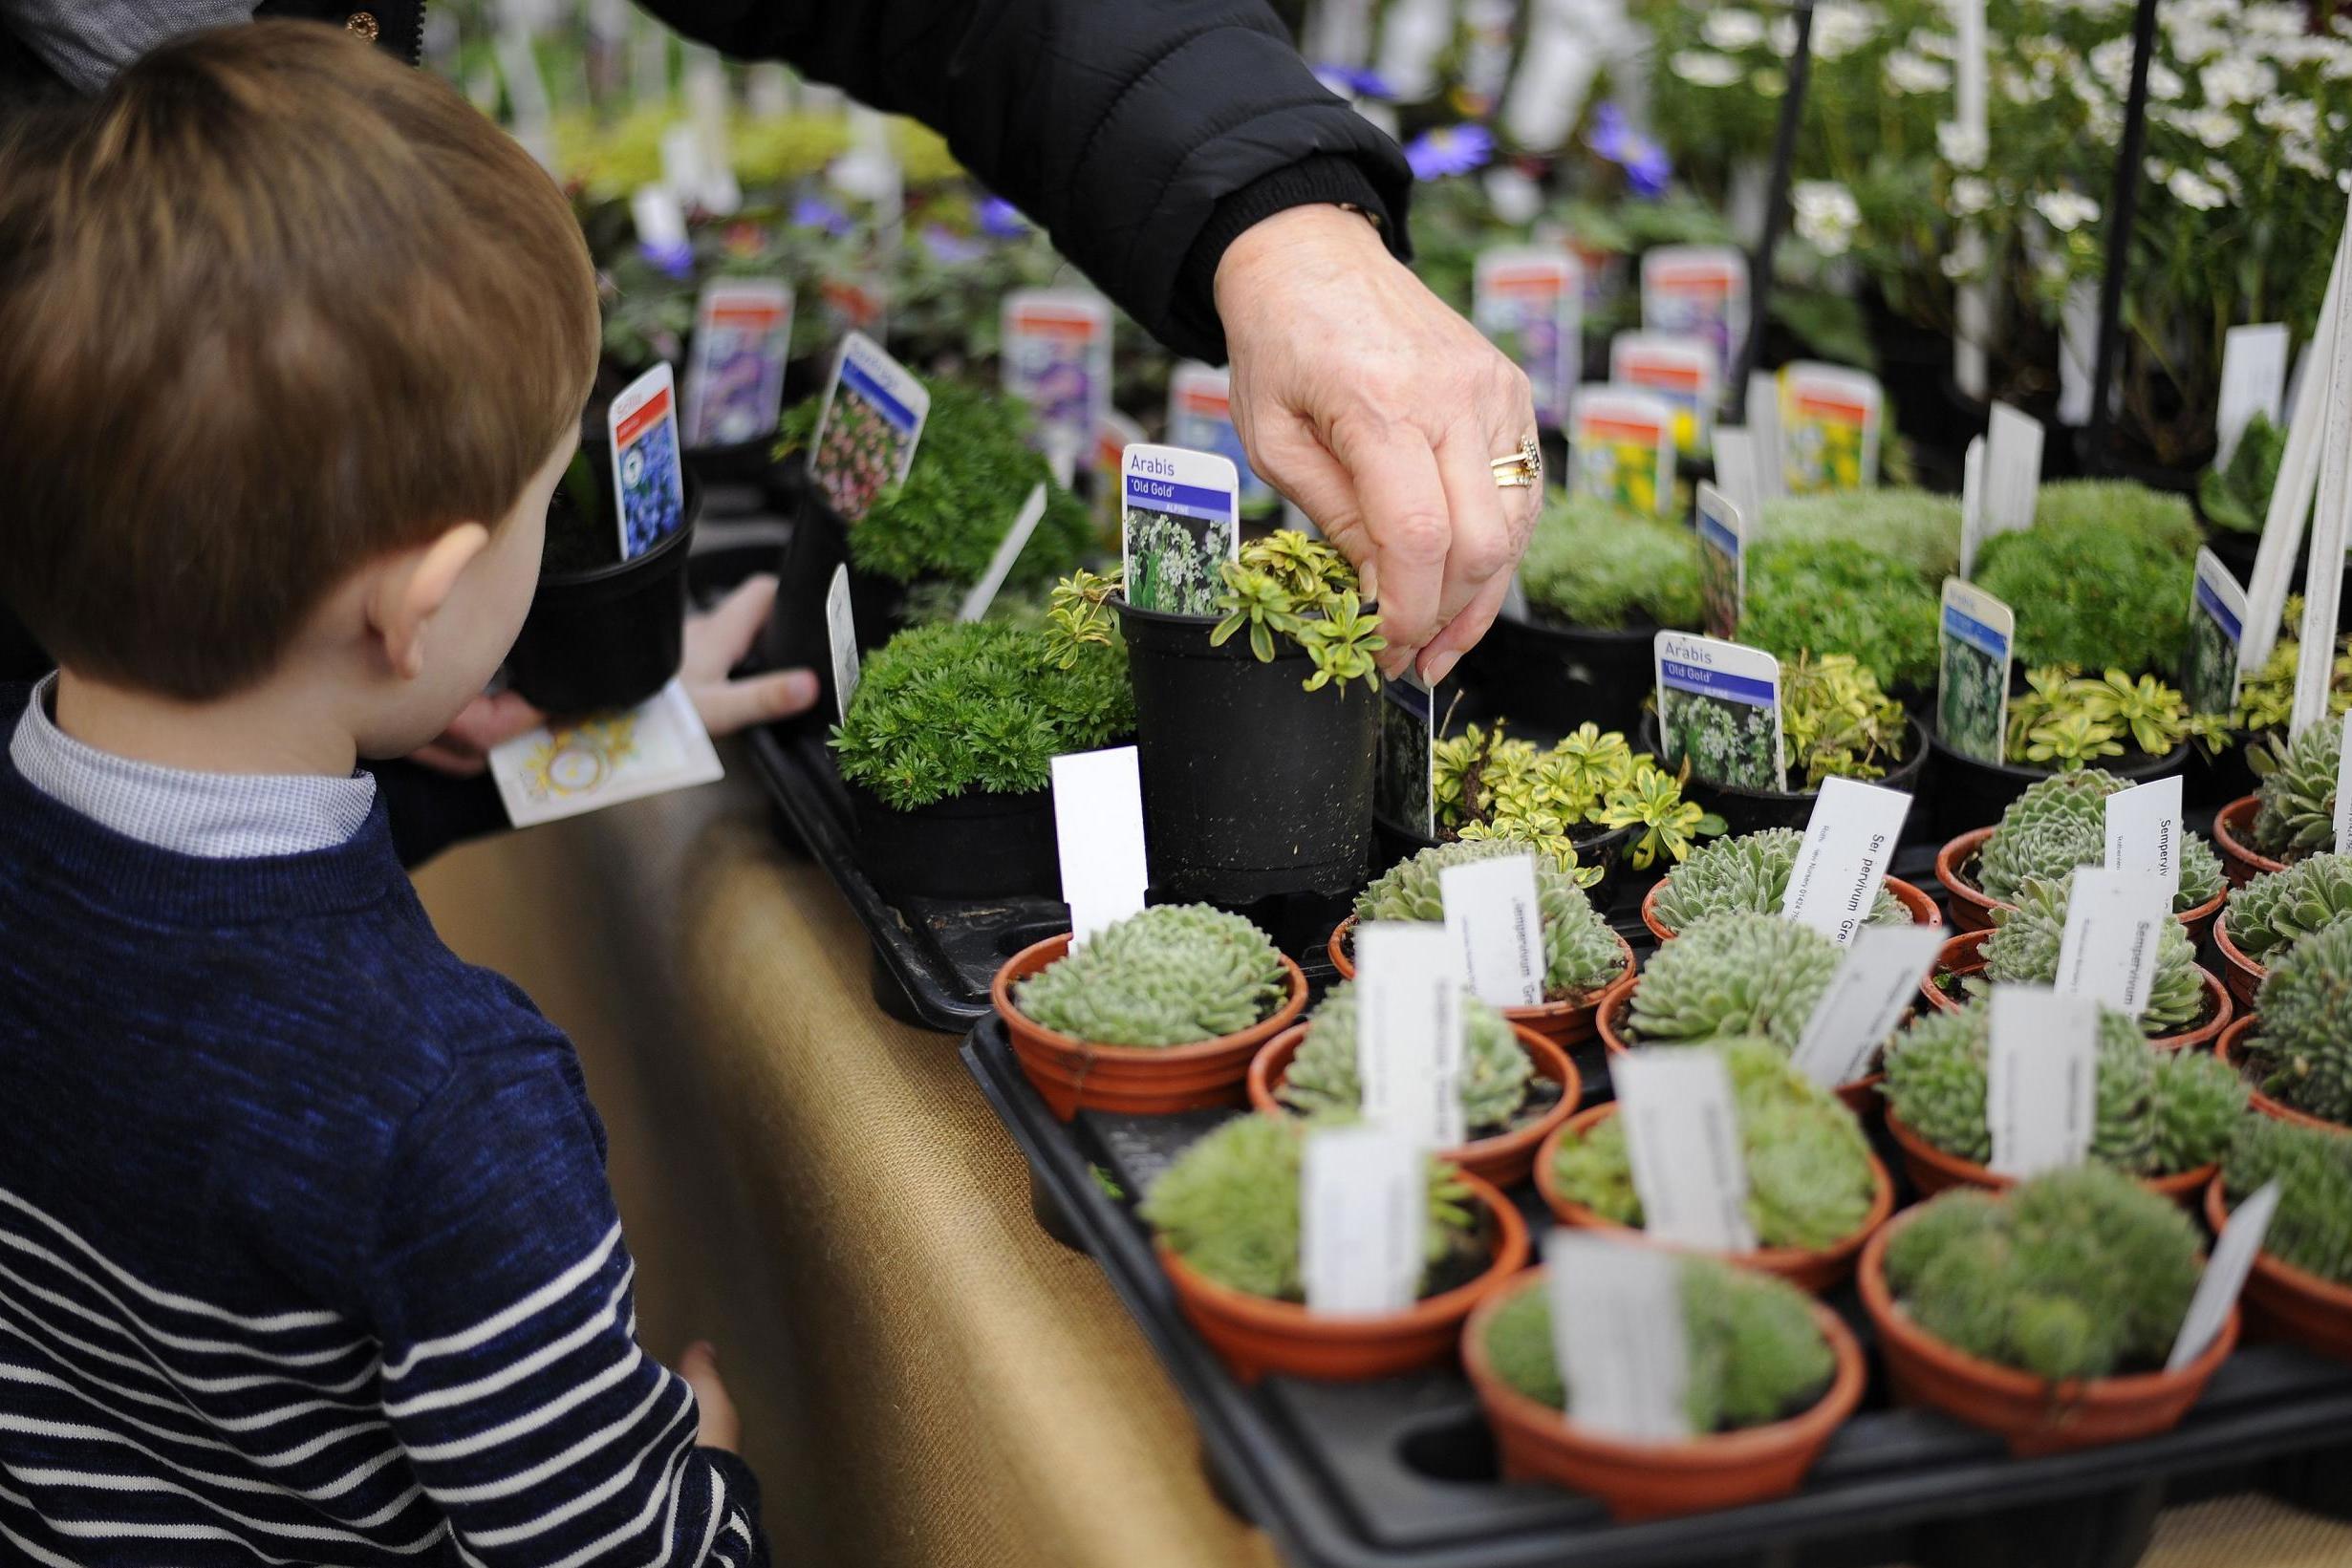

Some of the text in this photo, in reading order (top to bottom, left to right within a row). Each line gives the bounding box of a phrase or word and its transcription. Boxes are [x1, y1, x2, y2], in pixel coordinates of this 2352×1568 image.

[1131, 454, 1175, 476] Arabis
[1131, 479, 1175, 498] 'Old Gold'
[1665, 641, 1713, 664] Arabis
[2123, 920, 2149, 1005] Sempervivum
